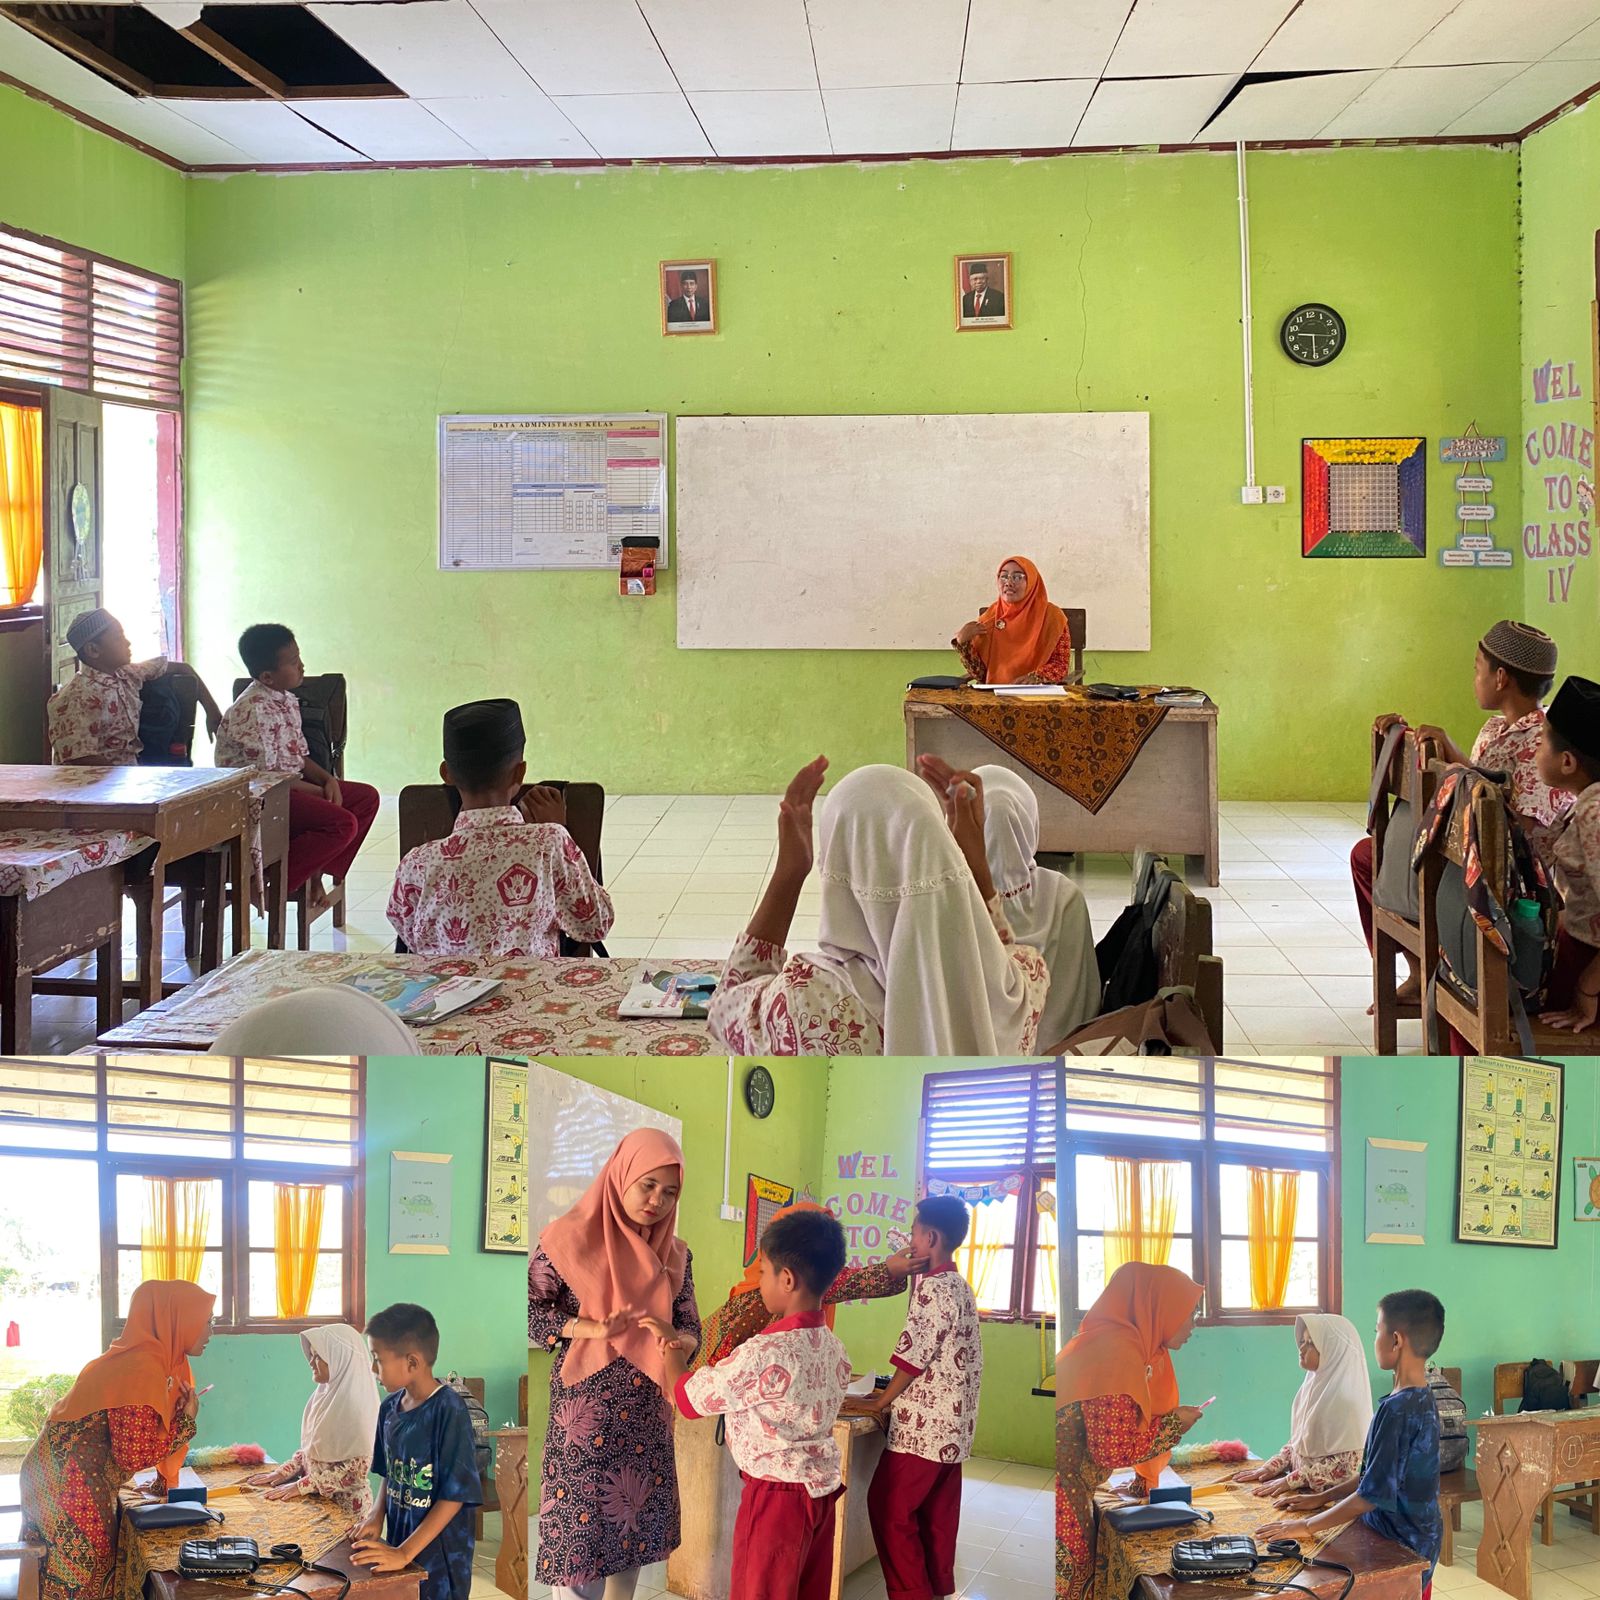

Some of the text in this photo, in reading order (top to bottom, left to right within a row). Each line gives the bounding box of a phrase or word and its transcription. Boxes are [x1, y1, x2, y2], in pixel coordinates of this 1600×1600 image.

[1533, 358, 1581, 404] WEL
[1526, 422, 1594, 469] COME
[1543, 475, 1572, 511] TO
[1523, 520, 1592, 559] CLASS
[1548, 564, 1575, 603] IV
[837, 1151, 898, 1179] WEL
[825, 1191, 912, 1224] COME
[847, 1225, 881, 1249] TO
